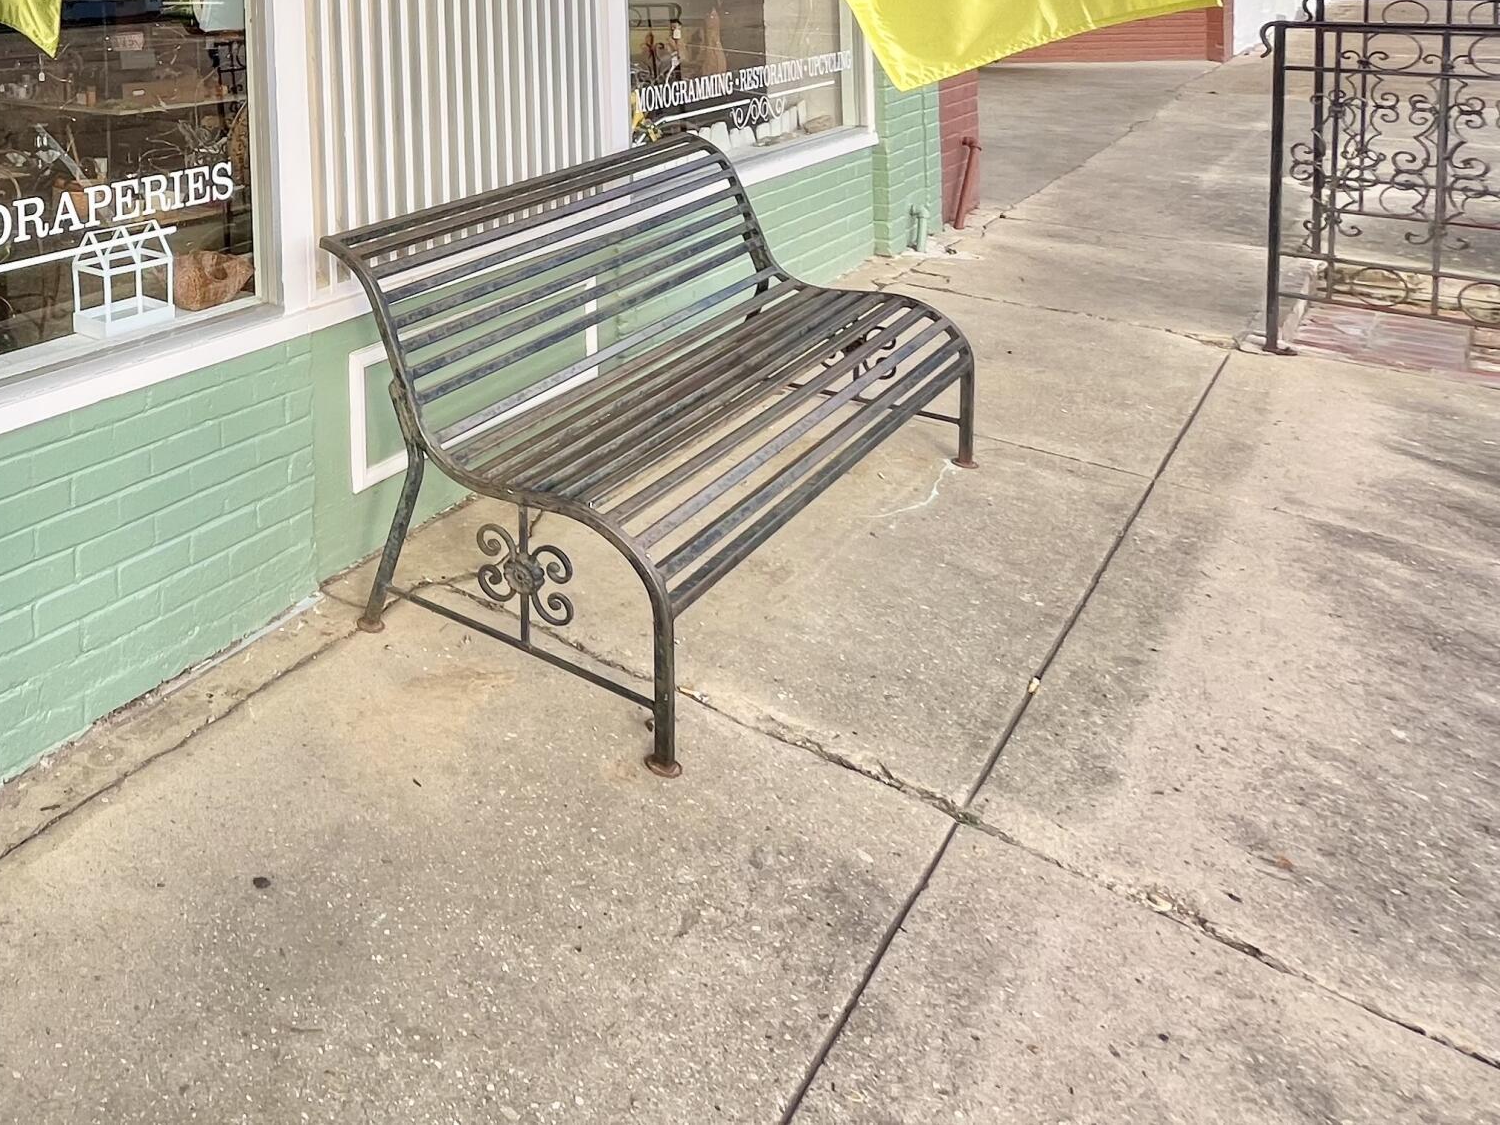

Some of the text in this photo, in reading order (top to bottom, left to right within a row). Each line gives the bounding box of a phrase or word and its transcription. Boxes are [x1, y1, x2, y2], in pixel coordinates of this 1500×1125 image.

[635, 50, 852, 114] MONOGRAMMING RESTORATION UPCYCLING
